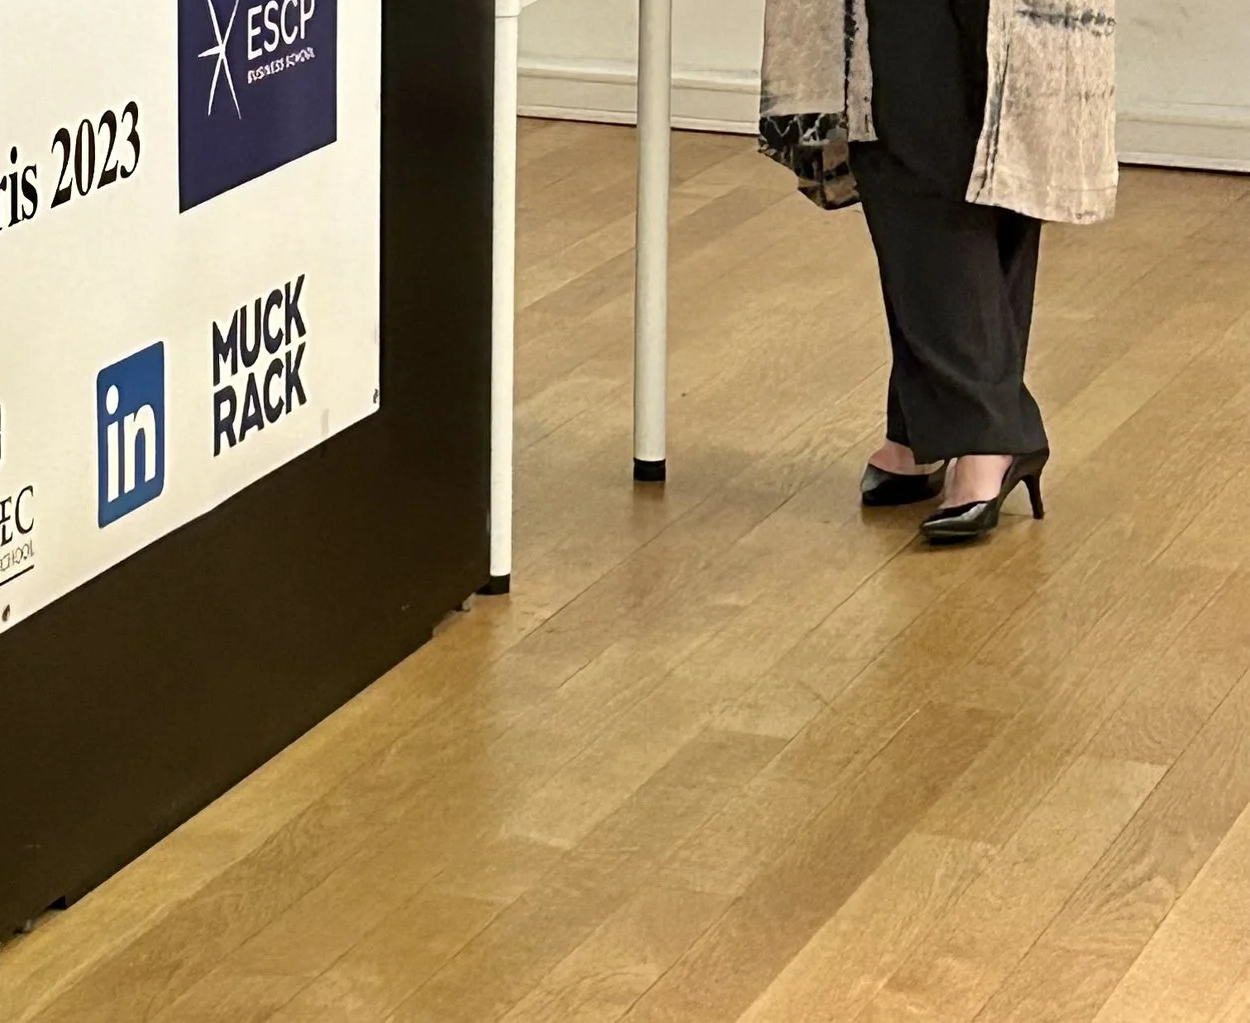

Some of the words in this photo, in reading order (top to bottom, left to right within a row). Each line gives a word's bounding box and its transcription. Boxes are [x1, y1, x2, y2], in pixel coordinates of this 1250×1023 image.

[50, 100, 141, 209] 2023
[212, 273, 307, 387] MUCK
[105, 384, 156, 503] in
[213, 341, 308, 458] RACK
